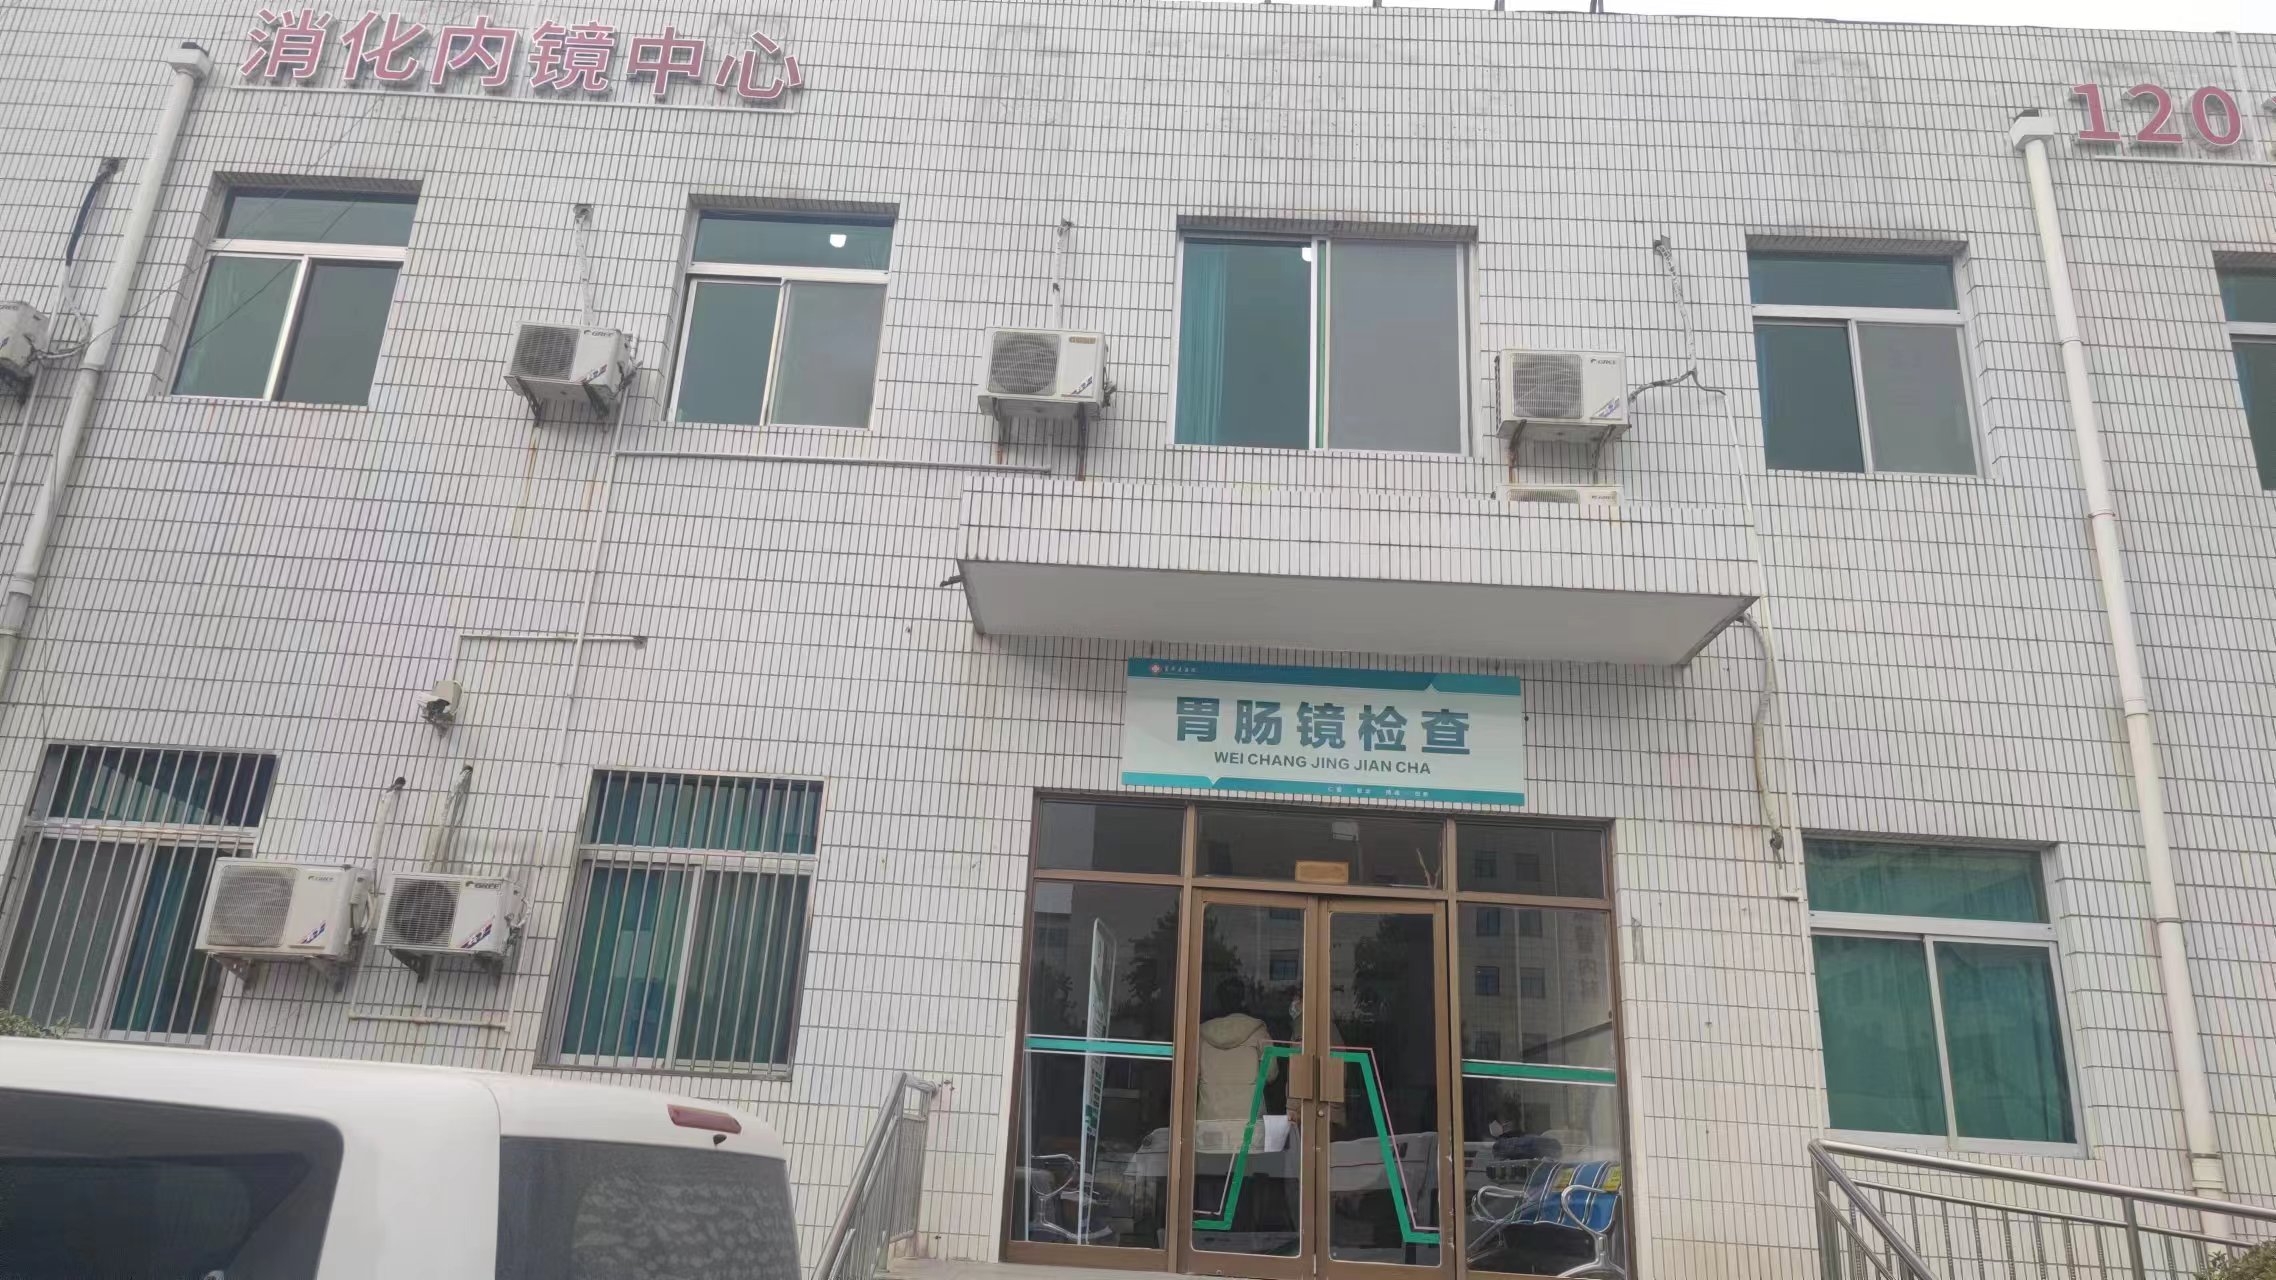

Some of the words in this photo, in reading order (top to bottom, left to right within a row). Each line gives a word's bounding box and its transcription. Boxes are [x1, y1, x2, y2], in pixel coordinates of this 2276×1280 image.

[239, 8, 804, 101] 消化内镜中心
[2072, 83, 2243, 147] 120
[1176, 696, 1471, 755] 胃肠镜检查
[1214, 751, 1244, 765] WEI
[1247, 753, 1307, 768] CHANG
[1311, 757, 1350, 770] JING
[1353, 759, 1392, 773] JIAN
[1395, 761, 1431, 774] CHA
